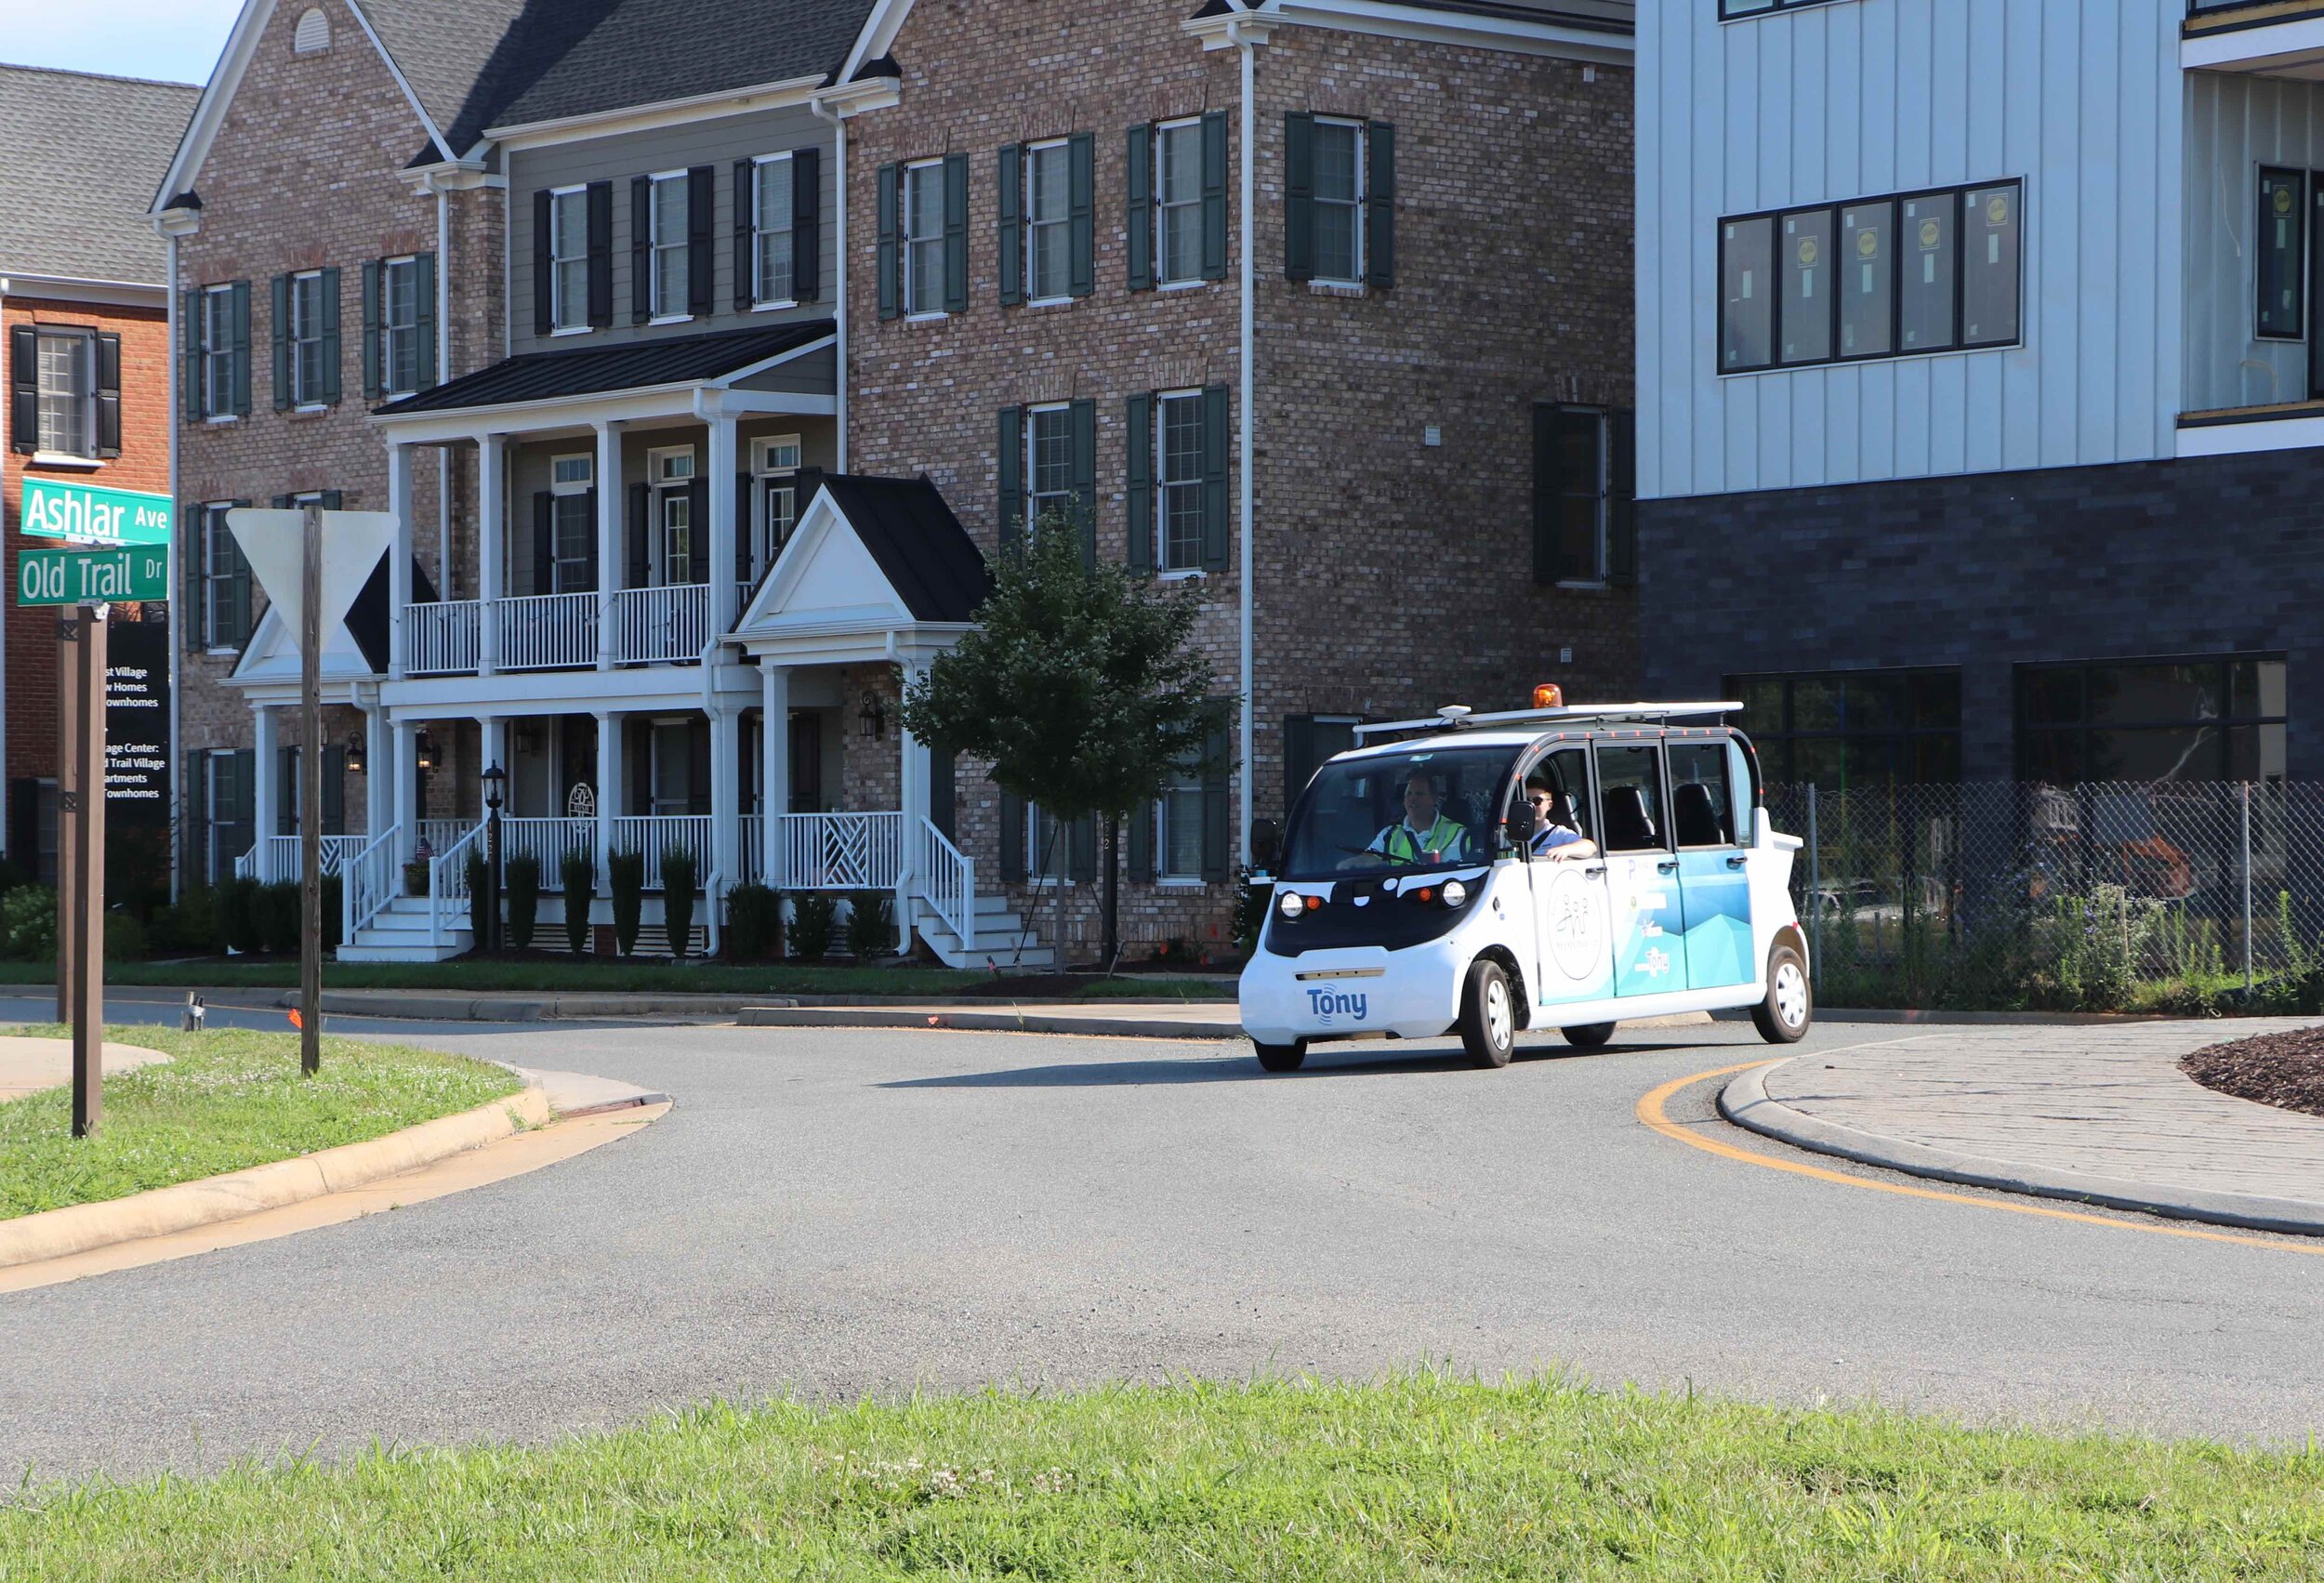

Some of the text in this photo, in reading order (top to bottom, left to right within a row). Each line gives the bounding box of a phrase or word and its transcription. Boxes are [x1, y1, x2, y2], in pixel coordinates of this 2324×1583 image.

[26, 489, 167, 537] Ashlar Ave
[23, 553, 163, 599] Old Trail Dr
[115, 666, 147, 679] Village
[113, 683, 147, 692] Homes
[106, 697, 158, 707] ownhomes
[125, 744, 159, 752] Center:
[110, 759, 132, 768] Trail
[133, 759, 165, 770] Village
[1645, 952, 1670, 974] Tony
[1307, 989, 1367, 1021] Tony
